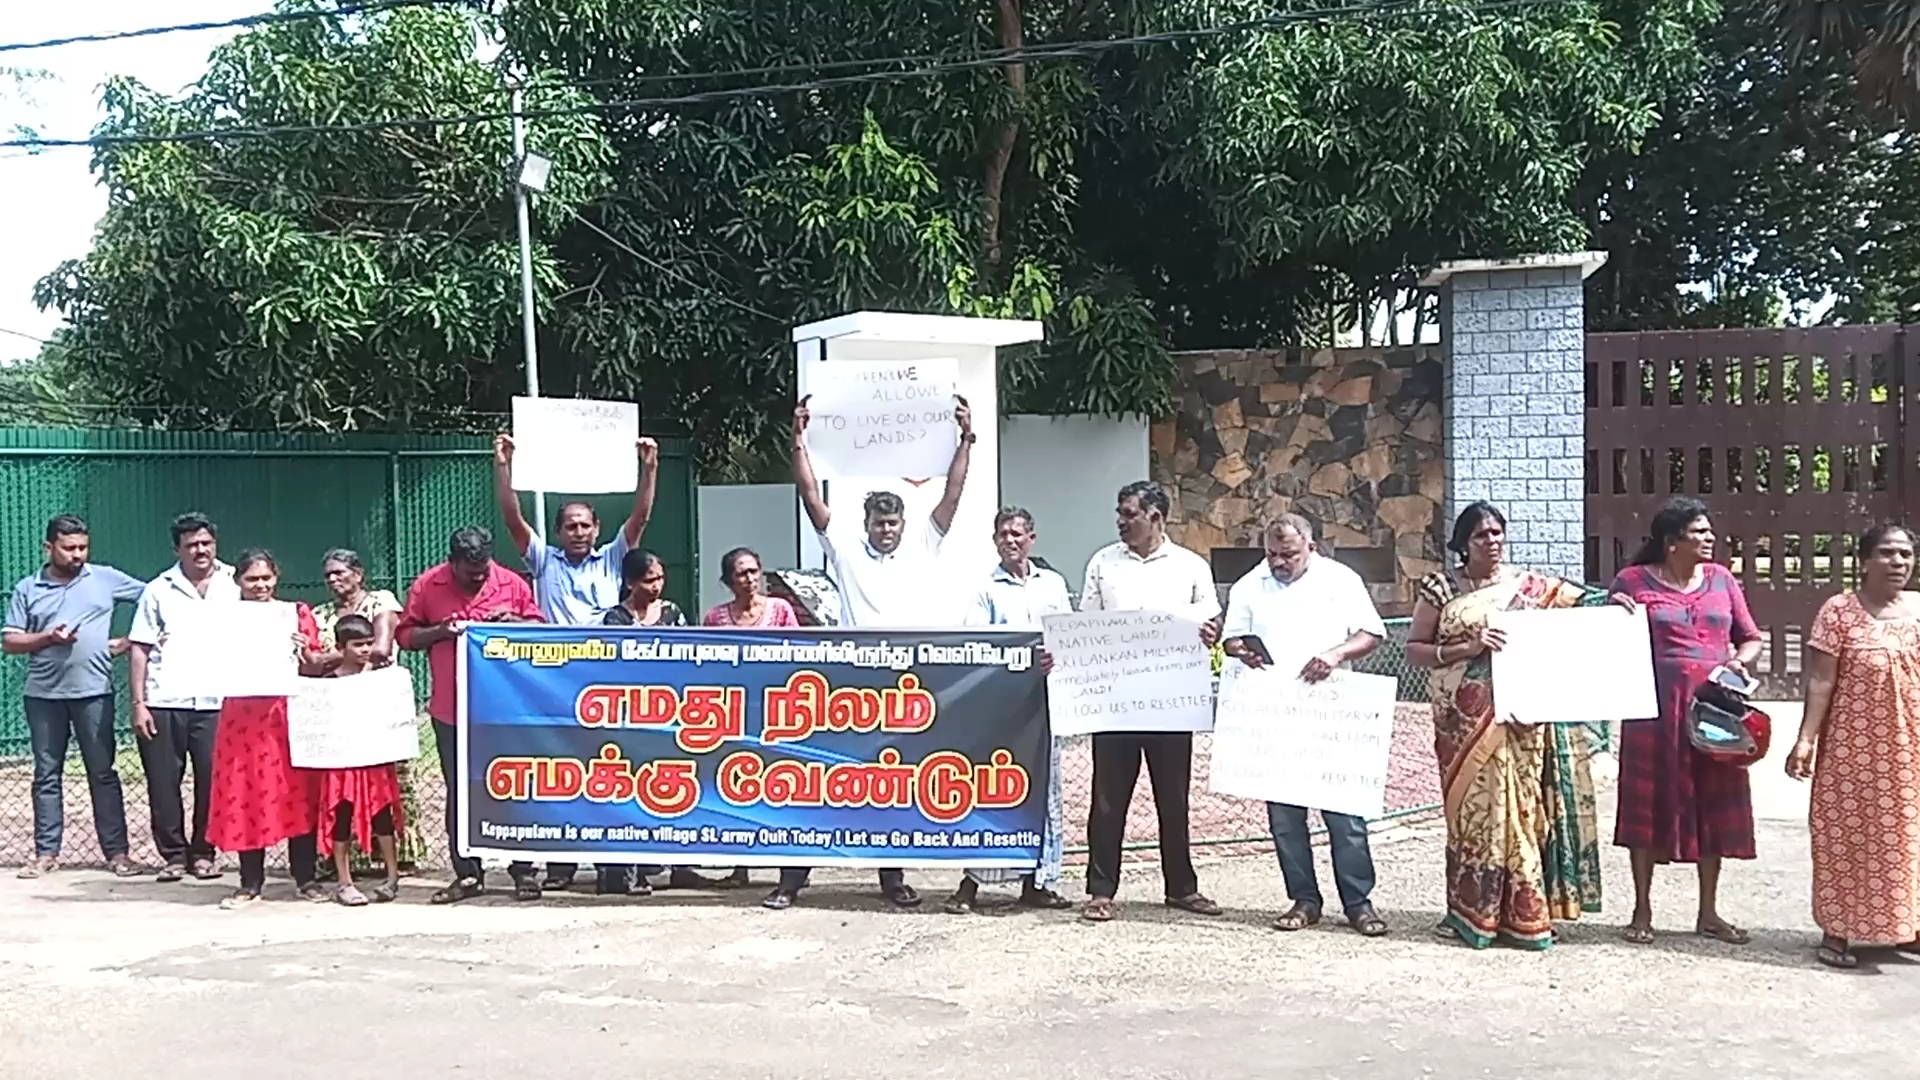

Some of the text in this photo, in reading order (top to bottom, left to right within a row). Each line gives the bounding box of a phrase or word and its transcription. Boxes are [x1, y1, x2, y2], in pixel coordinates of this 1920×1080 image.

[819, 410, 955, 431] TO LIVE ON OUR
[853, 429, 927, 449] LANDS?
[1059, 634, 1112, 649] NATIVE
[742, 639, 914, 670] மண்ணிலிருந்து
[1080, 650, 1138, 667] LANKAN
[576, 671, 937, 753] எமது நிலம்
[1109, 702, 1128, 714] US
[1132, 700, 1145, 712] TO
[487, 743, 1030, 824] எமக்கு வேண்டும்
[481, 821, 562, 841] Keppapulavu
[565, 824, 578, 840] is
[580, 827, 604, 840] our
[607, 825, 649, 841] native
[652, 825, 697, 845] village
[701, 826, 718, 843] SL
[721, 829, 756, 847] army
[759, 828, 788, 845] Quit
[793, 828, 832, 847] Today
[845, 830, 868, 846] Let
[871, 832, 887, 846] us
[891, 831, 909, 846] Go
[913, 831, 949, 847] Back
[952, 832, 979, 847] And
[984, 831, 1042, 847] Resettle
